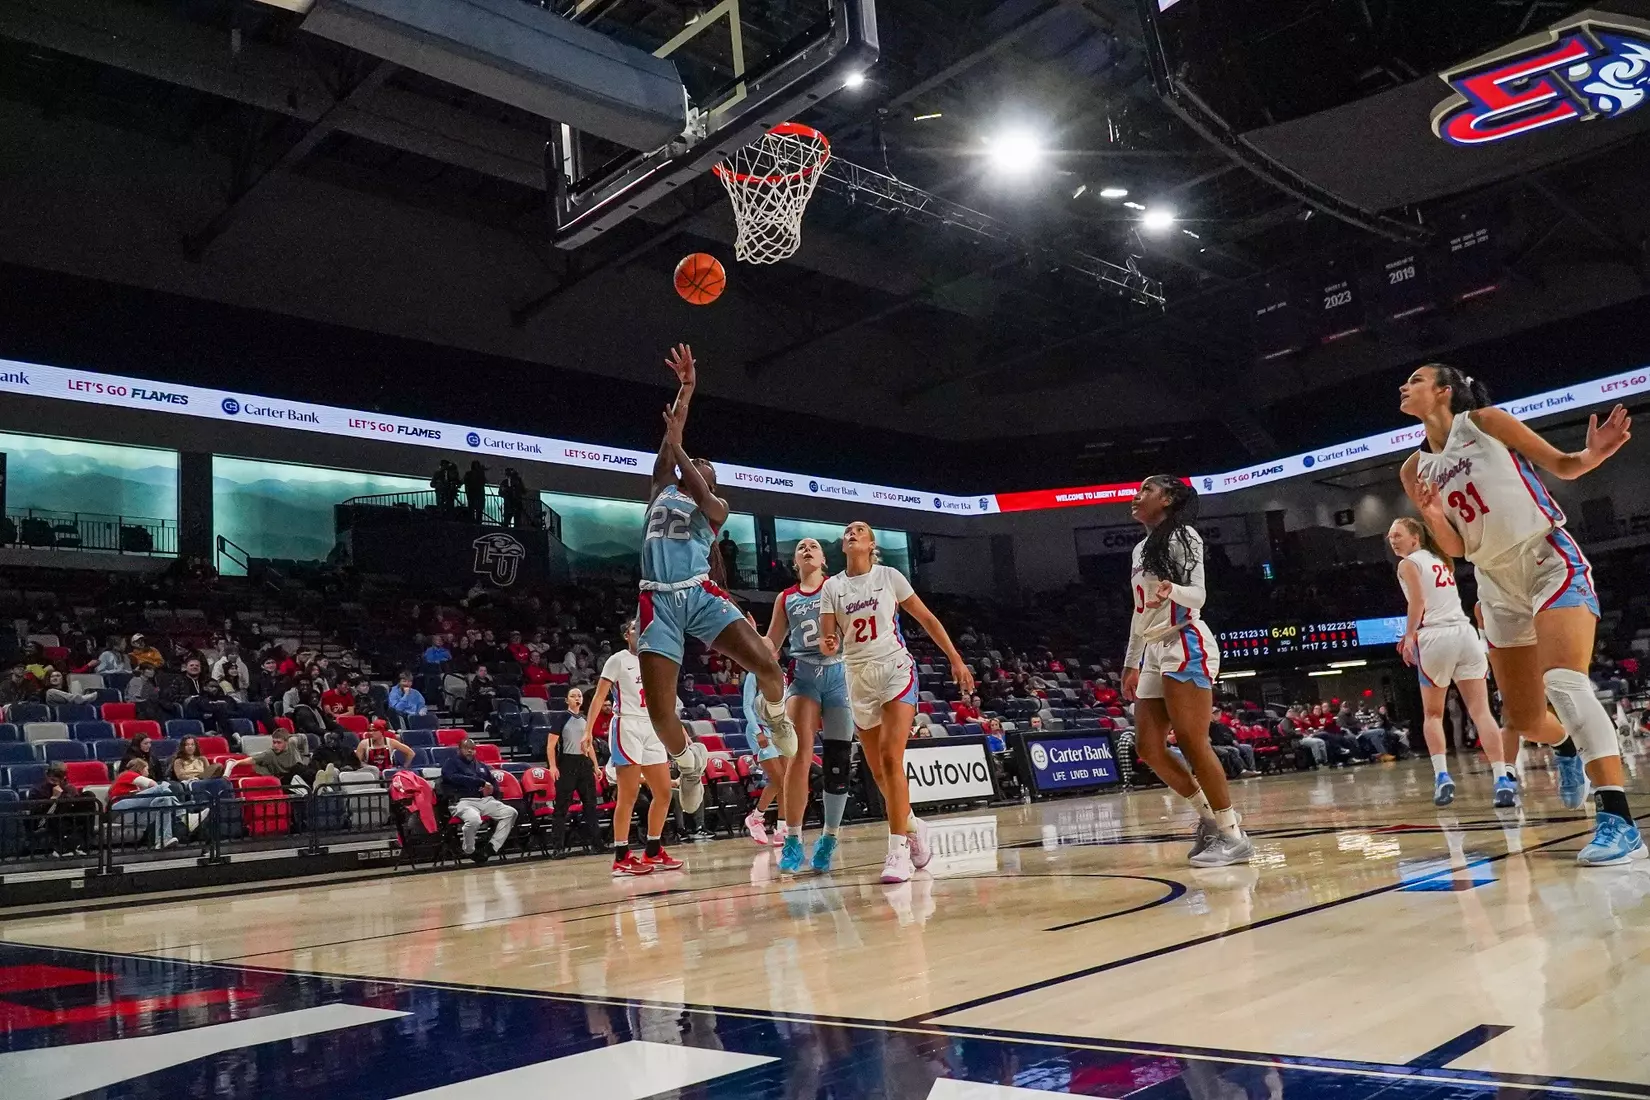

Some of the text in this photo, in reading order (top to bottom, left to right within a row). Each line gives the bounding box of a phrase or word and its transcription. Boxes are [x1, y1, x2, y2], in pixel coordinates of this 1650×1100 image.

[1388, 266, 1416, 285] 2019
[1324, 290, 1352, 310] 2023
[68, 379, 189, 405] LET'S GO FLAMES
[1601, 375, 1647, 393] LET'S GO
[1510, 392, 1575, 415] Carter Bank
[244, 403, 285, 420] Carter
[287, 409, 320, 424] Bank
[348, 418, 442, 440] LET'S GO FLAMES
[1390, 432, 1413, 444] LET'S
[483, 436, 516, 451] Carter
[517, 441, 542, 454] Bank
[1317, 444, 1370, 464] Carter Bank
[564, 448, 638, 466] LET'S GO FLAMES
[735, 472, 794, 488] LET'S GO FLAMES
[1238, 474, 1250, 482] GO
[1252, 465, 1284, 479] FLAMES
[820, 484, 859, 497] Carter Bank
[872, 491, 887, 500] LET'S
[898, 494, 921, 504] FLAMES
[1056, 492, 1084, 502] WELCOME
[1084, 492, 1093, 500] TO
[1094, 490, 1116, 498] LIBERTY
[1448, 481, 1490, 524] 31
[646, 505, 692, 540] 22
[845, 596, 880, 615] Liberty
[853, 615, 878, 643] 21
[1220, 632, 1226, 640] 0
[1229, 632, 1238, 640] 12
[1240, 630, 1248, 638] 21
[1248, 630, 1258, 638] 23
[1259, 628, 1268, 637] 31
[1272, 626, 1296, 638] 6:40
[1308, 624, 1314, 632] 3
[1317, 624, 1326, 632] 18
[1327, 622, 1337, 631] 22
[1337, 622, 1347, 630] 23
[1347, 620, 1356, 630] 25
[1223, 650, 1229, 658] 2
[1243, 648, 1249, 656] 3
[1263, 646, 1269, 655] 2
[1310, 642, 1319, 651] 17
[1322, 642, 1328, 650] 2
[1332, 640, 1337, 648] 5
[1342, 640, 1347, 648] 3
[1352, 639, 1358, 647] 0
[1050, 747, 1084, 764] Carter
[1086, 743, 1113, 761] Bank
[906, 760, 988, 788] Autova
[1052, 768, 1110, 782] LIFE LIVED FULL
